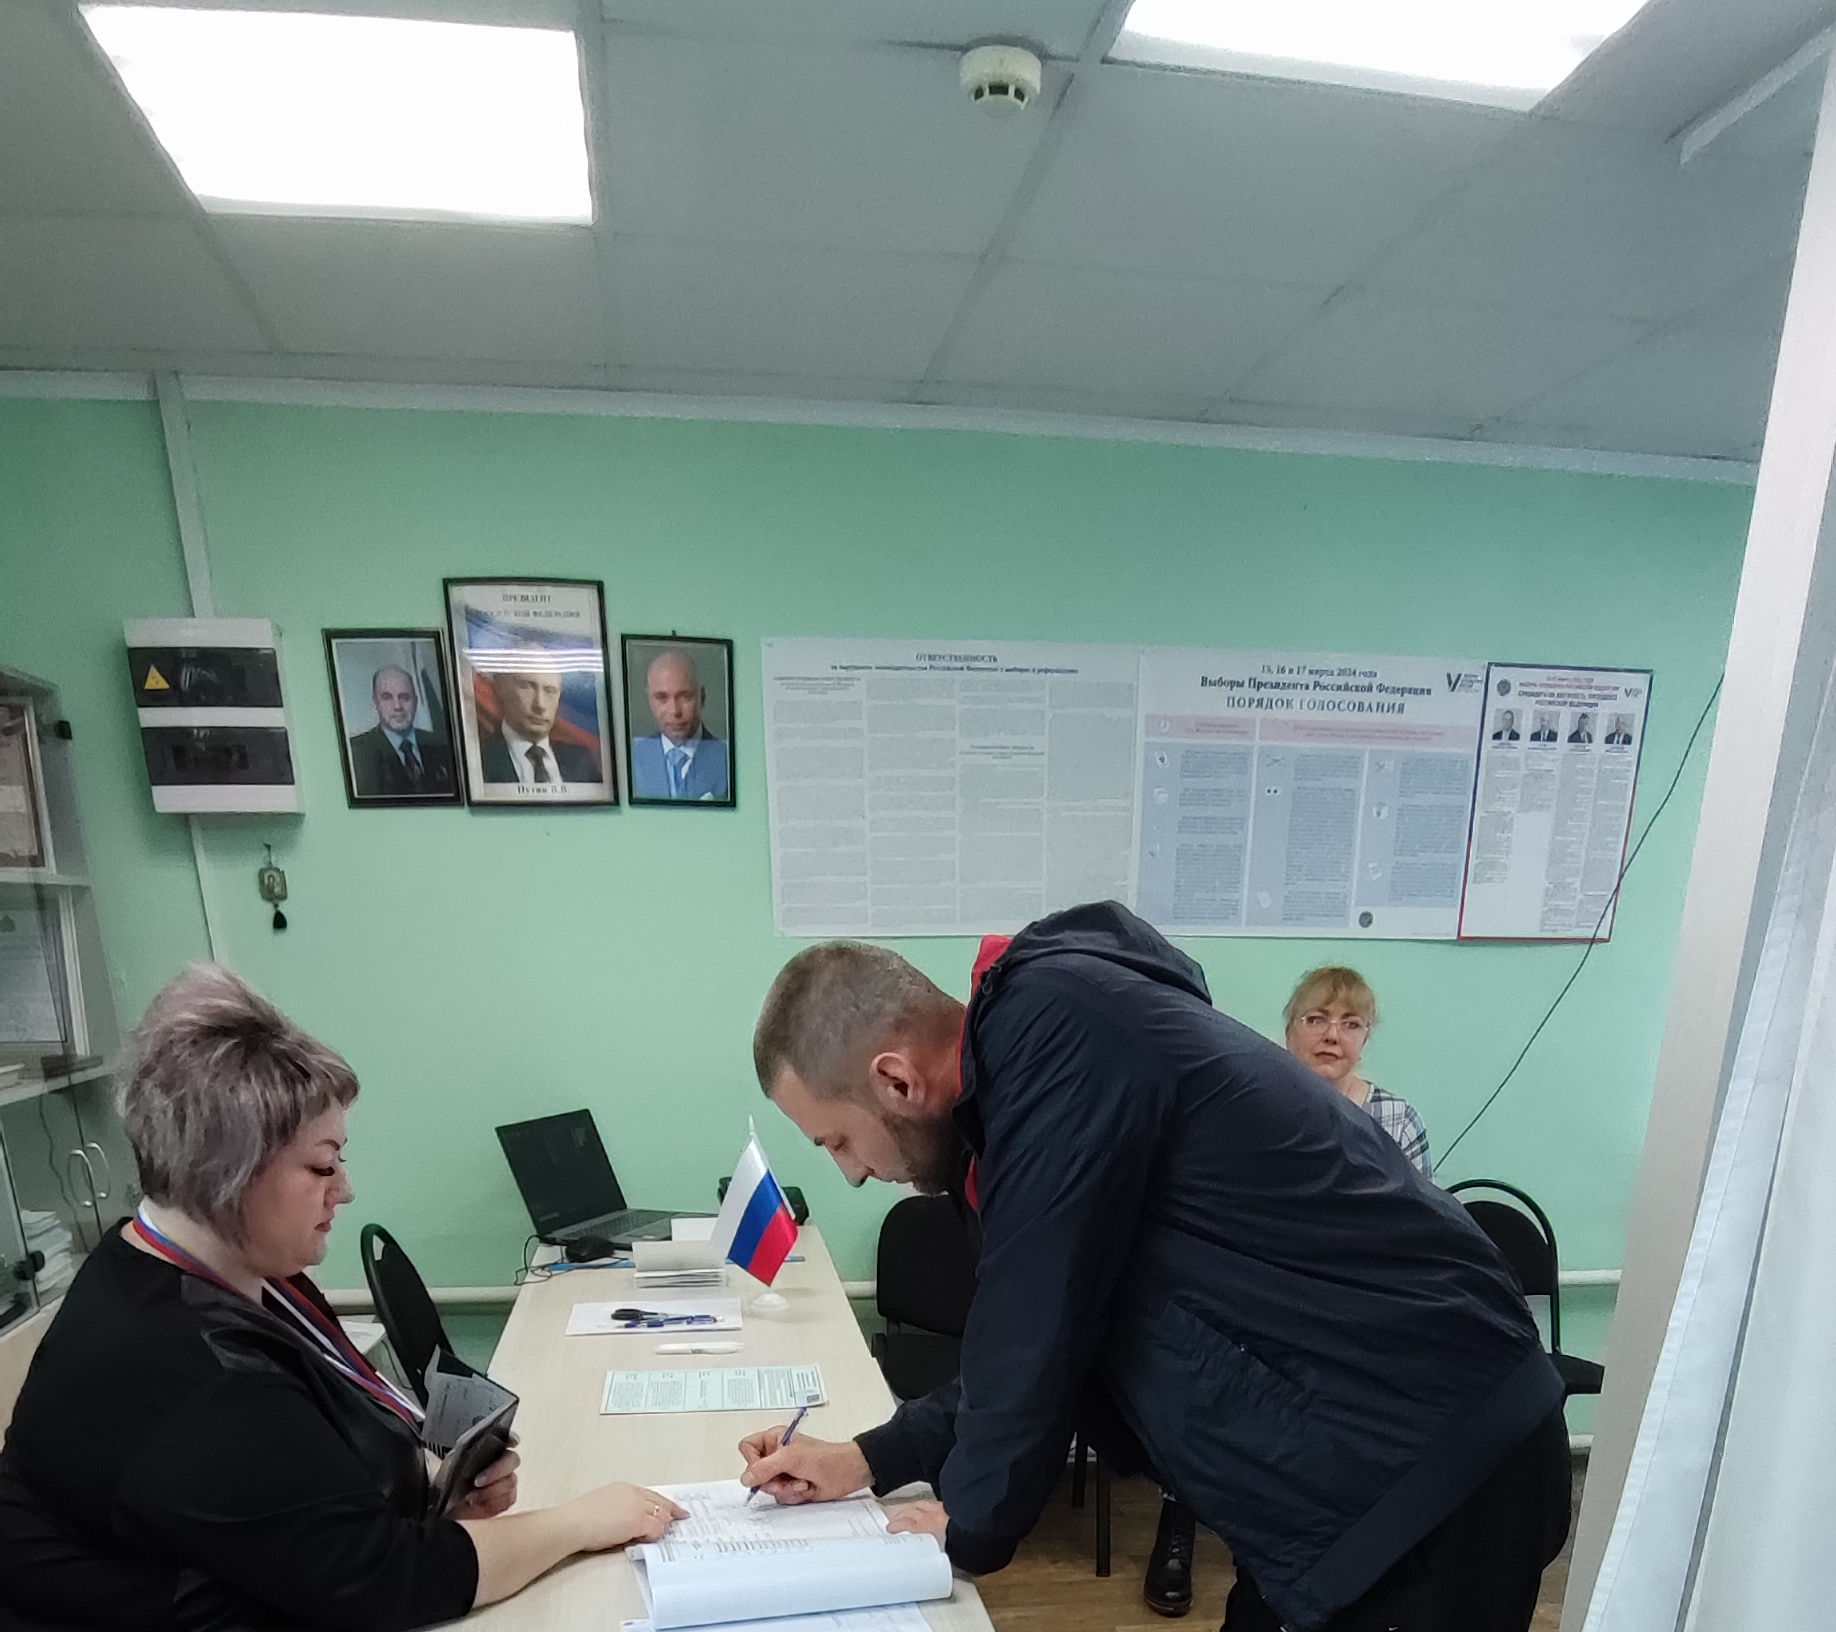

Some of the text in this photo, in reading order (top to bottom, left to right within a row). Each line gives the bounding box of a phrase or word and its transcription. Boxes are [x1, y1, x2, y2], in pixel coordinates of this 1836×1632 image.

[1277, 665, 1286, 675] 16
[1296, 665, 1307, 675] 17
[1201, 676, 1432, 697] Выборы Президента Российской Федерации
[1226, 696, 1405, 714] ПОРЯДОК ГОЛОСОВАНИЯ
